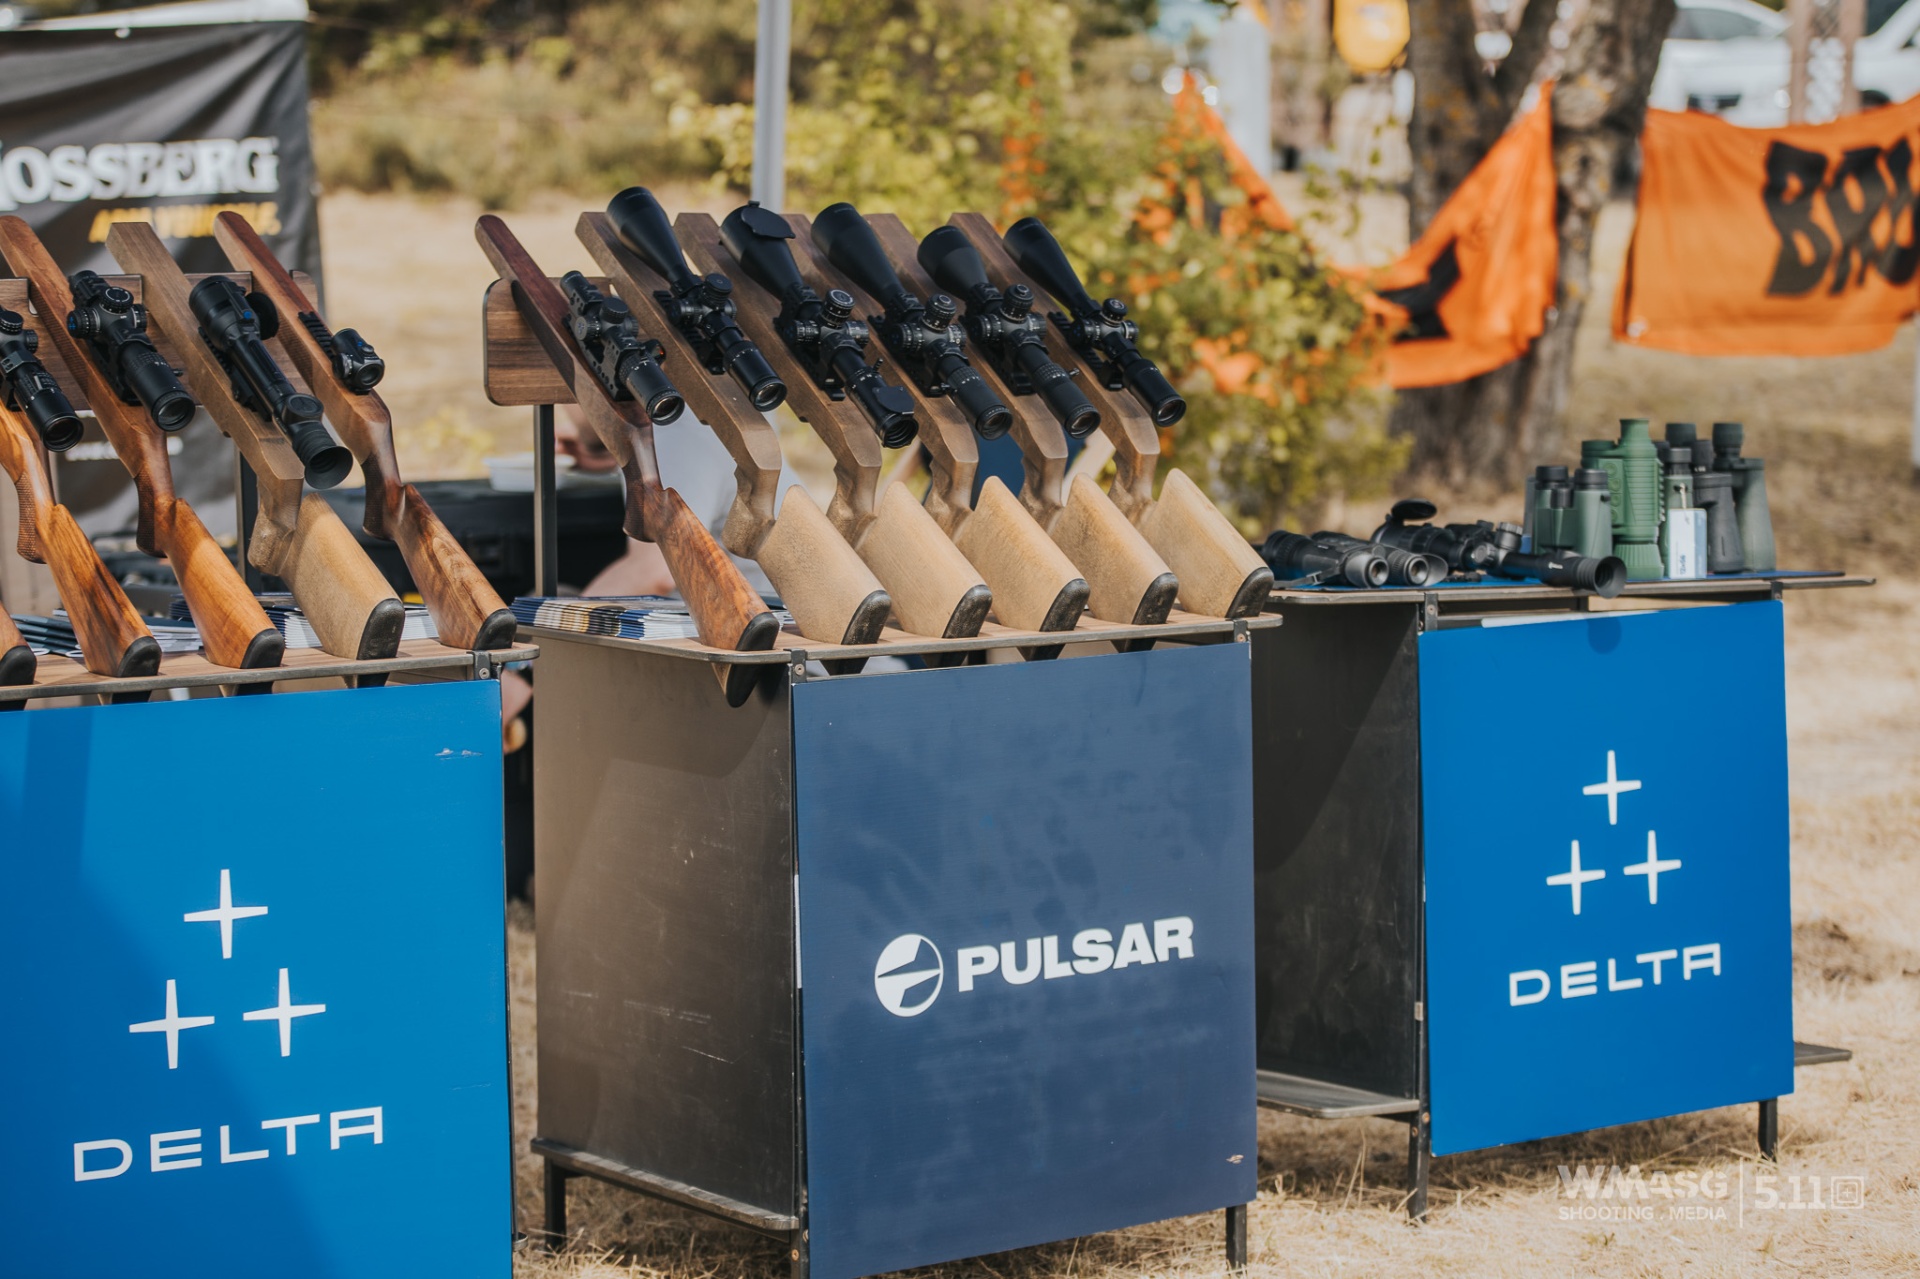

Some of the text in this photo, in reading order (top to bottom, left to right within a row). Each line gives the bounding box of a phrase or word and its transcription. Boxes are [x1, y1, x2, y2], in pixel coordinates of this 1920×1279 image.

[0, 137, 279, 211] OSSBERG
[957, 915, 1195, 993] PULSAR
[1509, 942, 1722, 1007] DELTA
[73, 1106, 384, 1182] DELTA
